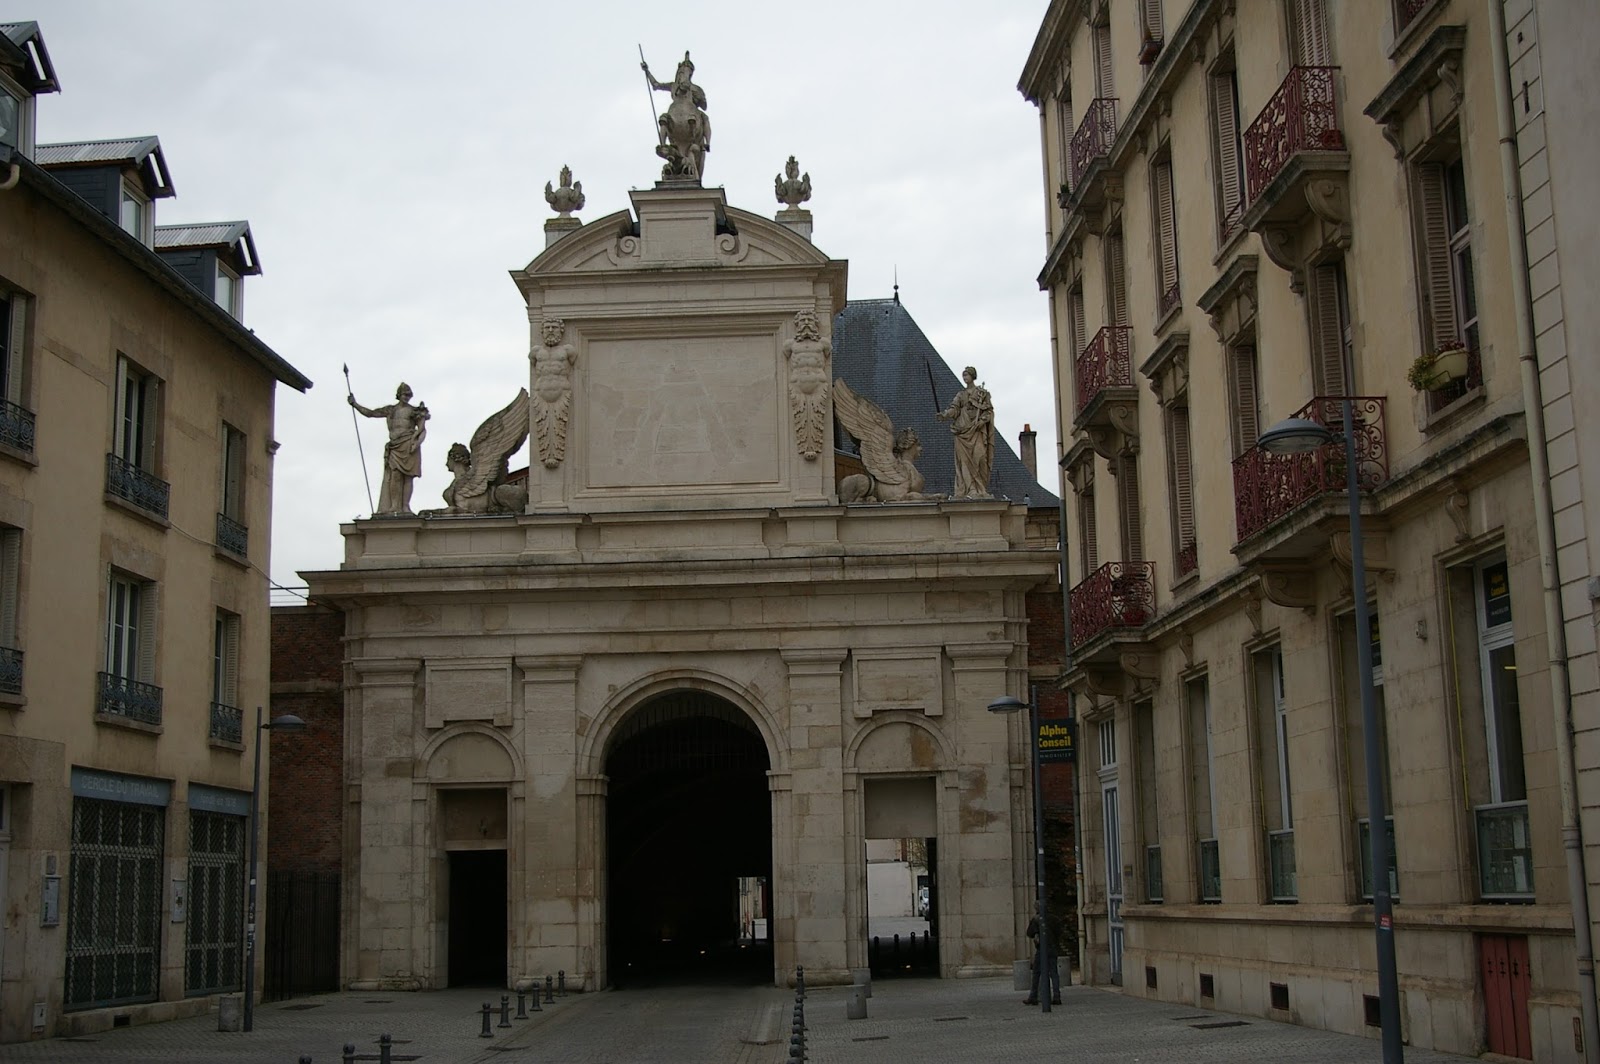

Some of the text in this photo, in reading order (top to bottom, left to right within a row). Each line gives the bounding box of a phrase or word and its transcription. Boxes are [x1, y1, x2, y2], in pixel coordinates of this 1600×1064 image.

[1039, 724, 1068, 737] Alpha
[81, 775, 159, 798] CERCLE DU TRAVAIL
